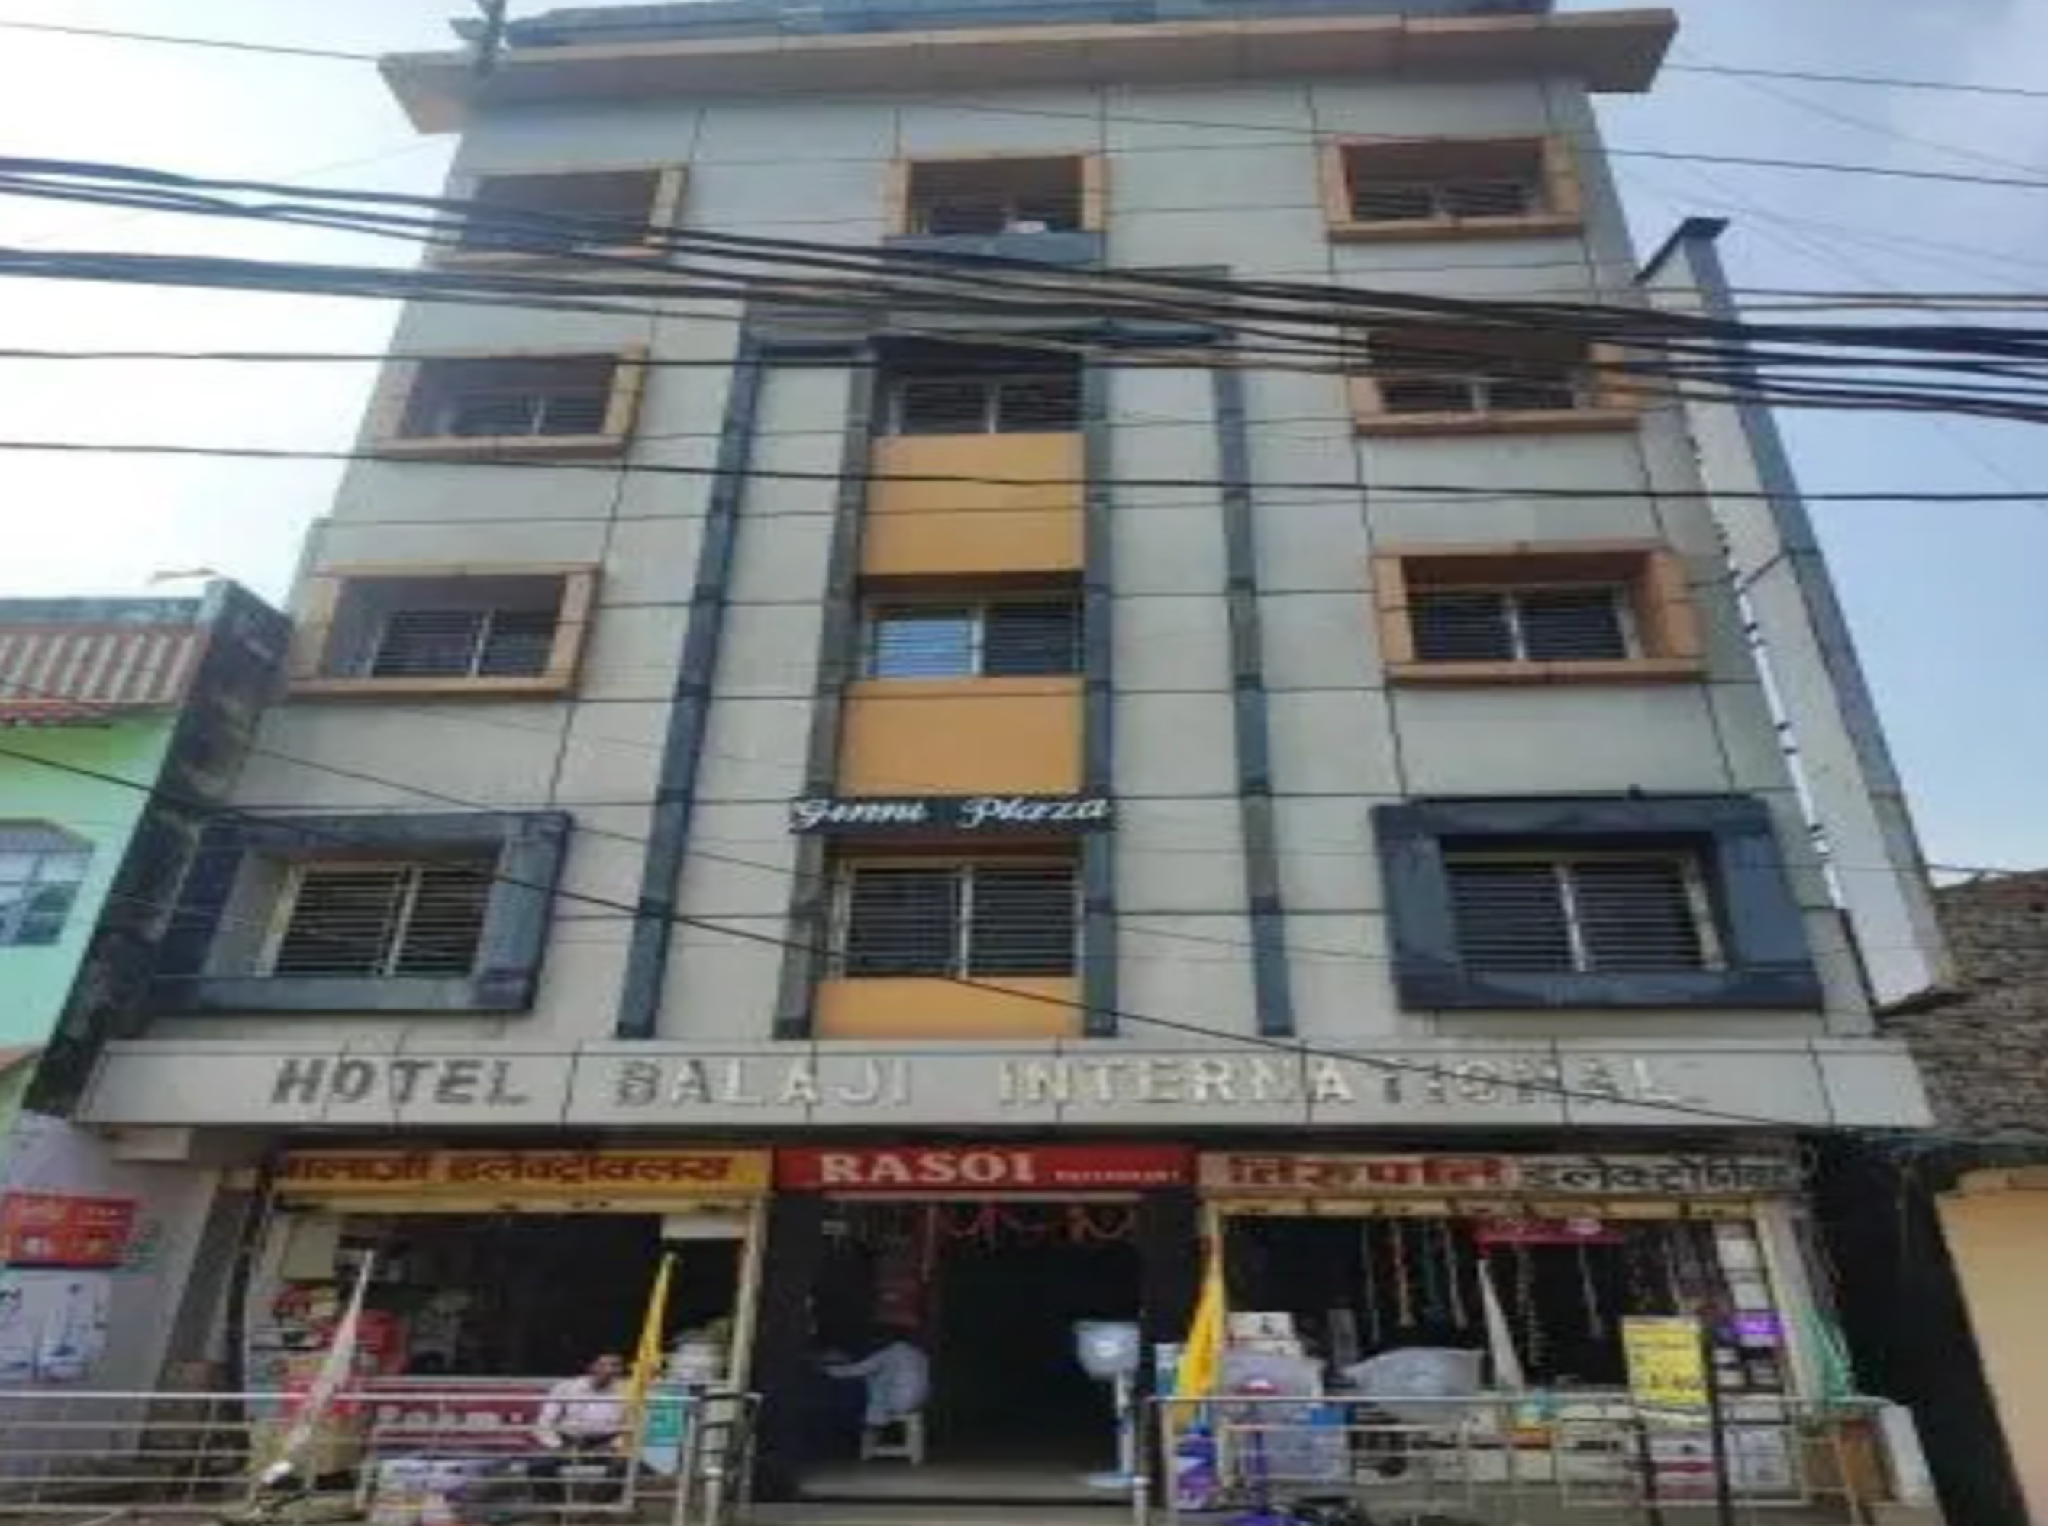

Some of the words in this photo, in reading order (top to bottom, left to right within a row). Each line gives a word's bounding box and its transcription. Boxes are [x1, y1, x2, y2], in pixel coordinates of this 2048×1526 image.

[957, 796, 1108, 829] Plaza
[271, 1057, 532, 1105] HOTEL
[612, 1057, 912, 1106] BALAJI
[819, 1152, 1037, 1184] RASOI
